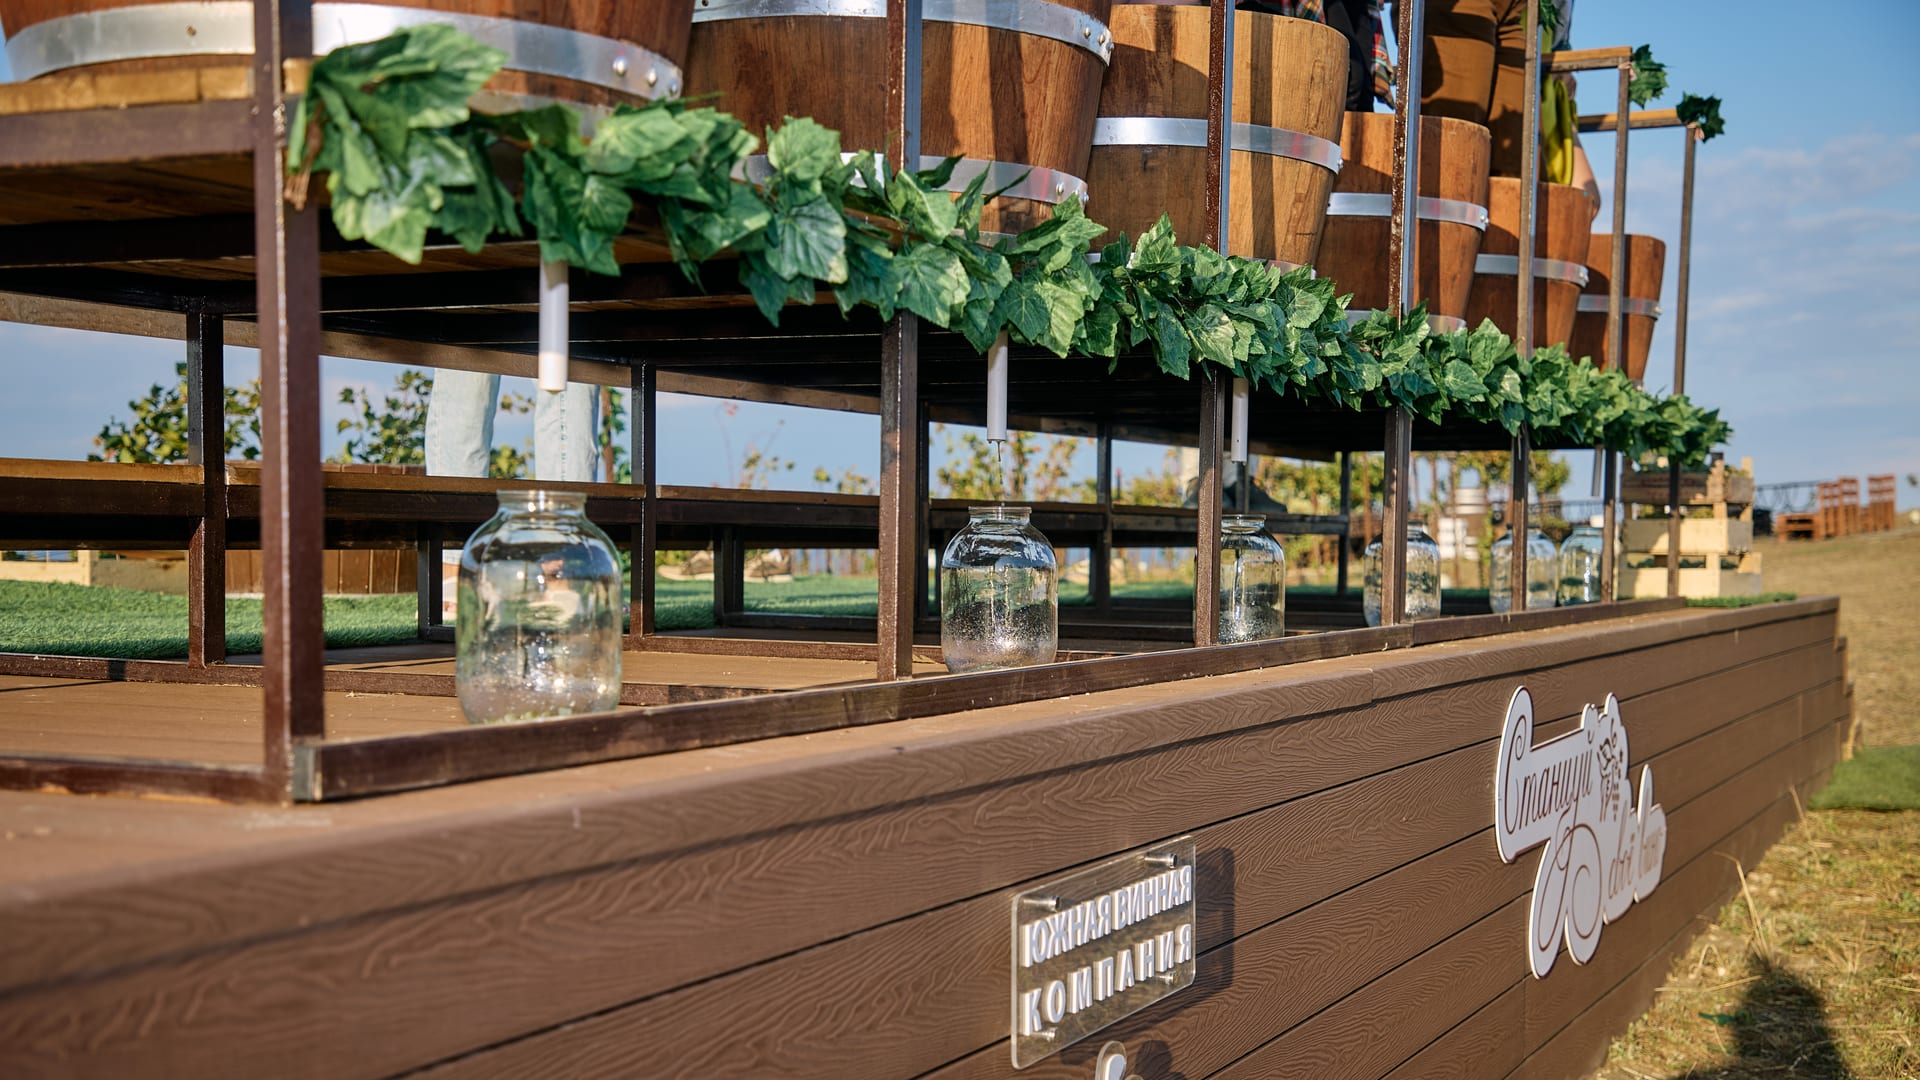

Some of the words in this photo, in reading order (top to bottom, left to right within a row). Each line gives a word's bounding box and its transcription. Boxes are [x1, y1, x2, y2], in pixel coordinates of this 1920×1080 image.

[1022, 894, 1112, 968] ЮЖНАЯ
[1113, 864, 1192, 931] ВИННАЯ
[1022, 923, 1192, 1037] КОМПАНИЯ
